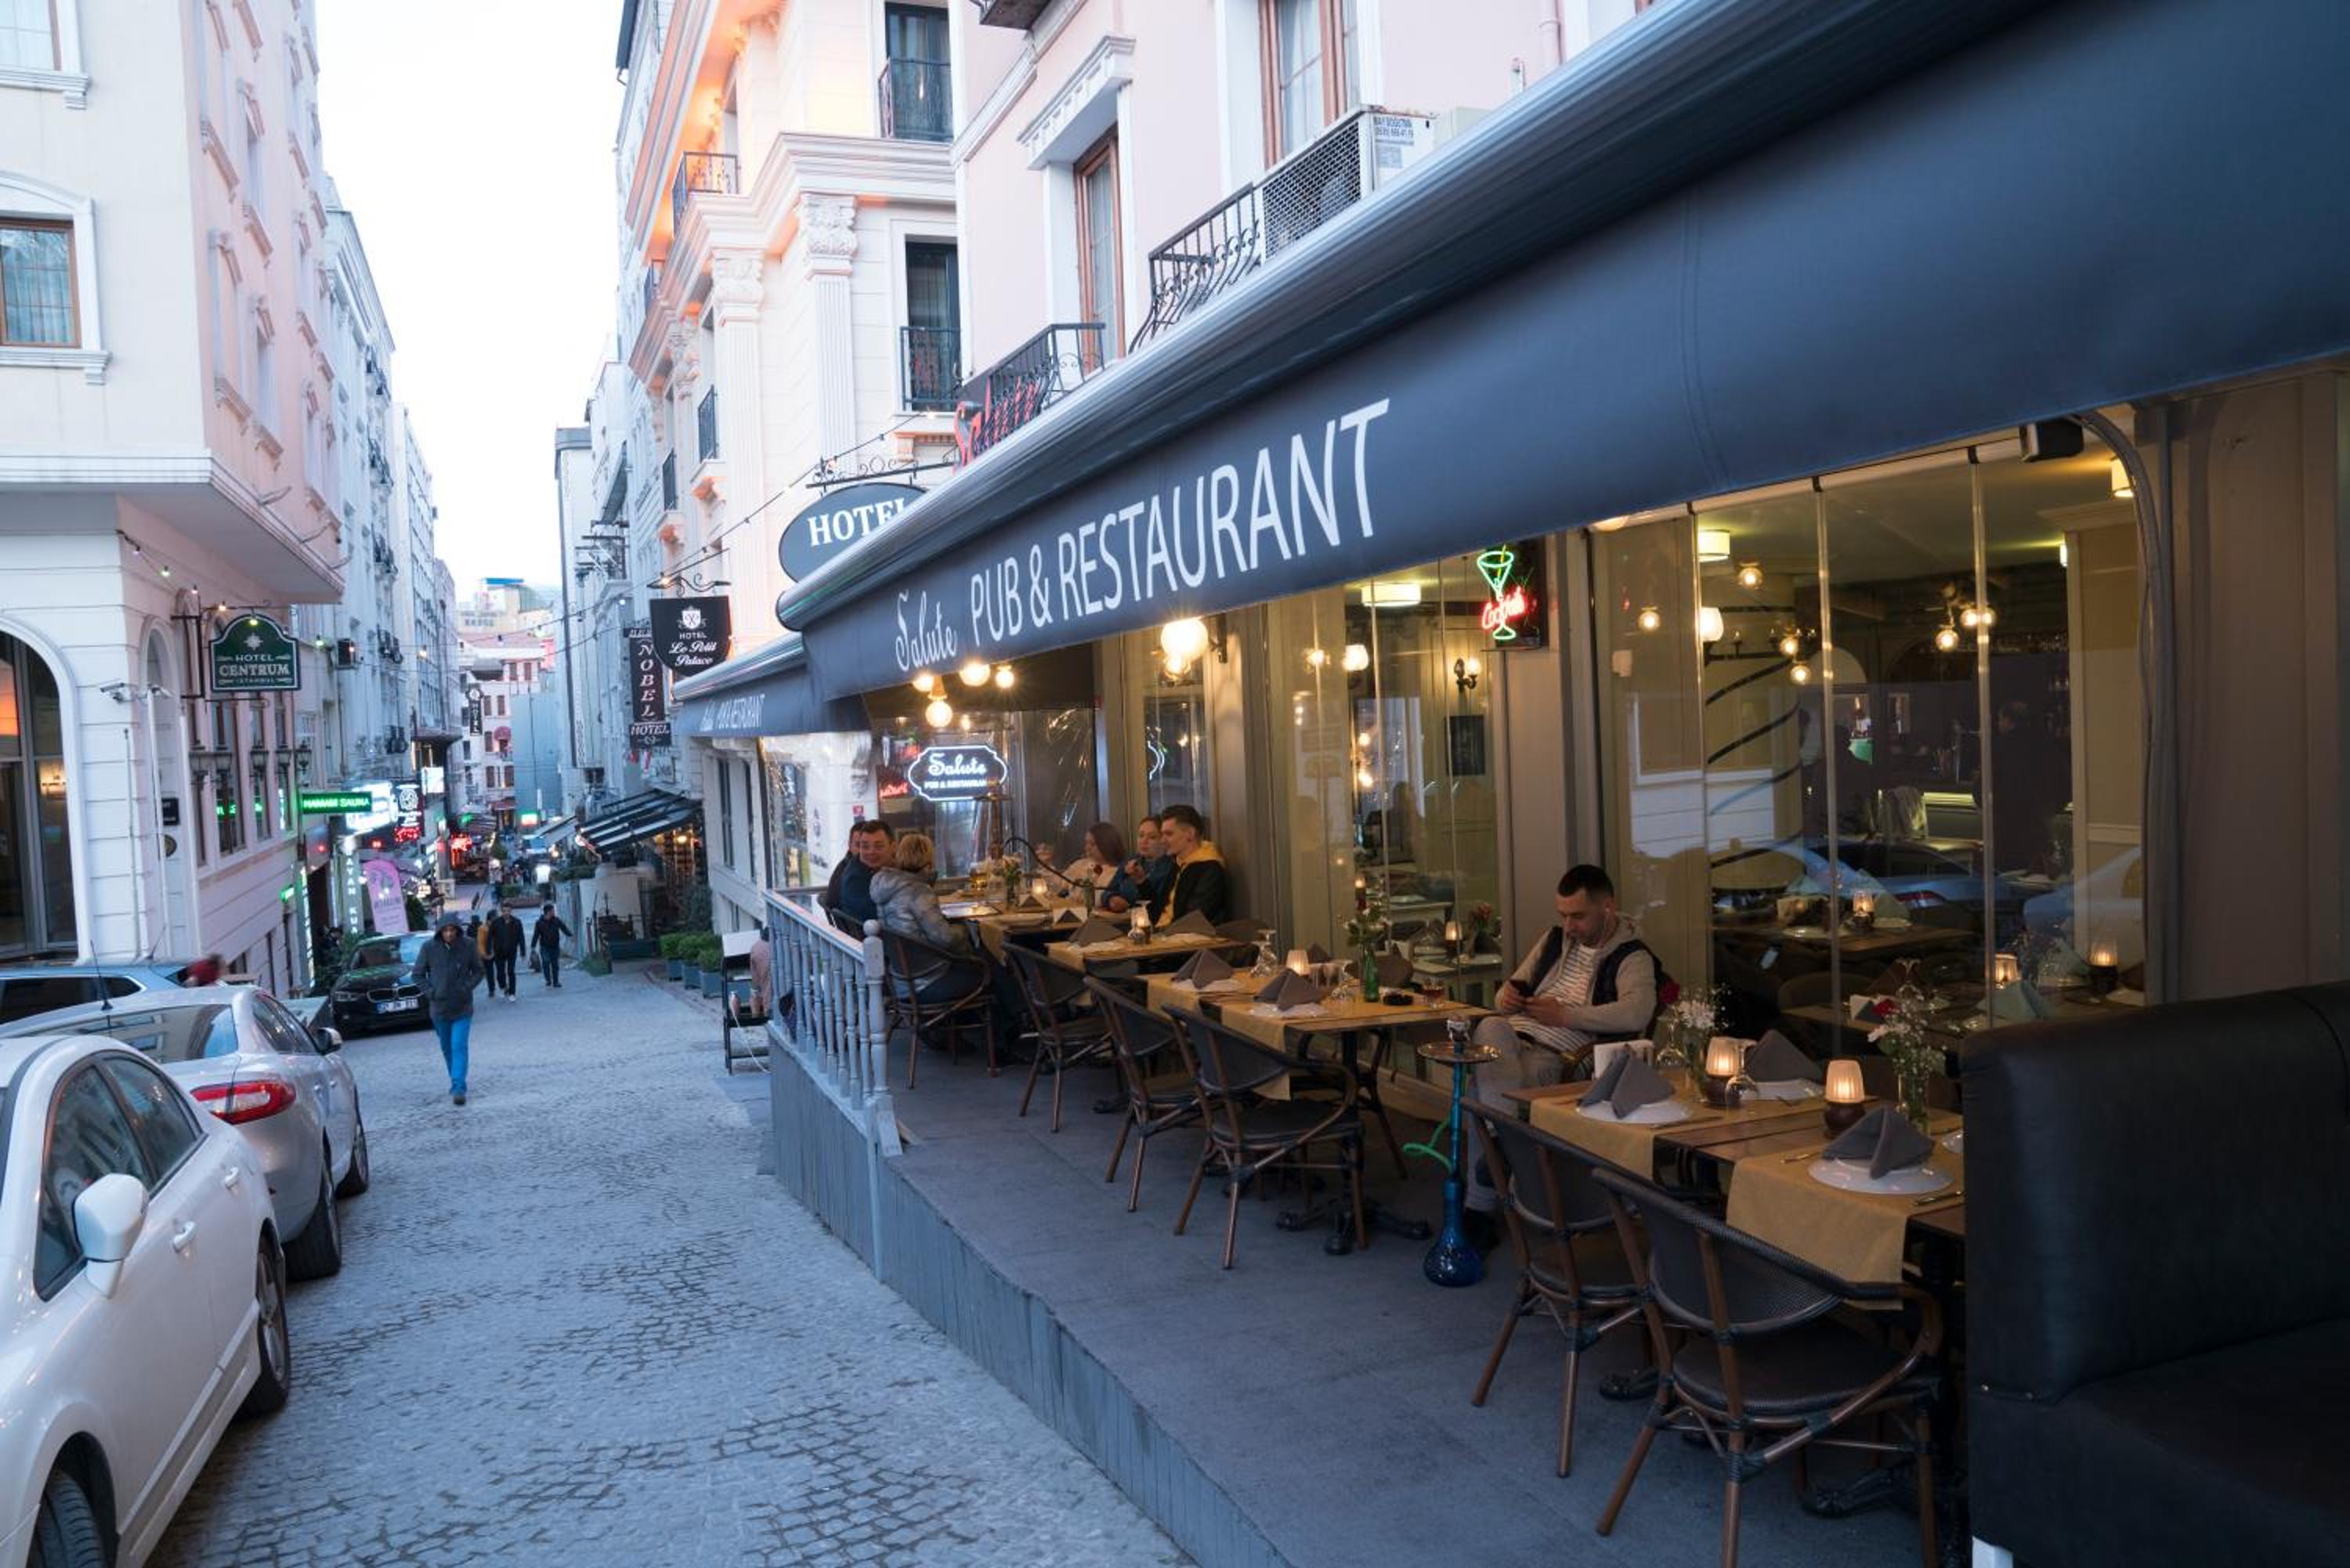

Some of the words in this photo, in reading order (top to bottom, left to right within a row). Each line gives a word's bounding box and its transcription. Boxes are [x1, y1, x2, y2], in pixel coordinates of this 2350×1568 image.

[895, 589, 957, 672] Salute
[971, 557, 1022, 647] PUB
[1030, 544, 1054, 628] &
[1058, 398, 1390, 622] RESTAURANT
[219, 663, 291, 677] CENTRUM
[638, 644, 656, 717] NOBEL
[631, 724, 670, 735] HOTEL
[928, 753, 988, 776] Salute
